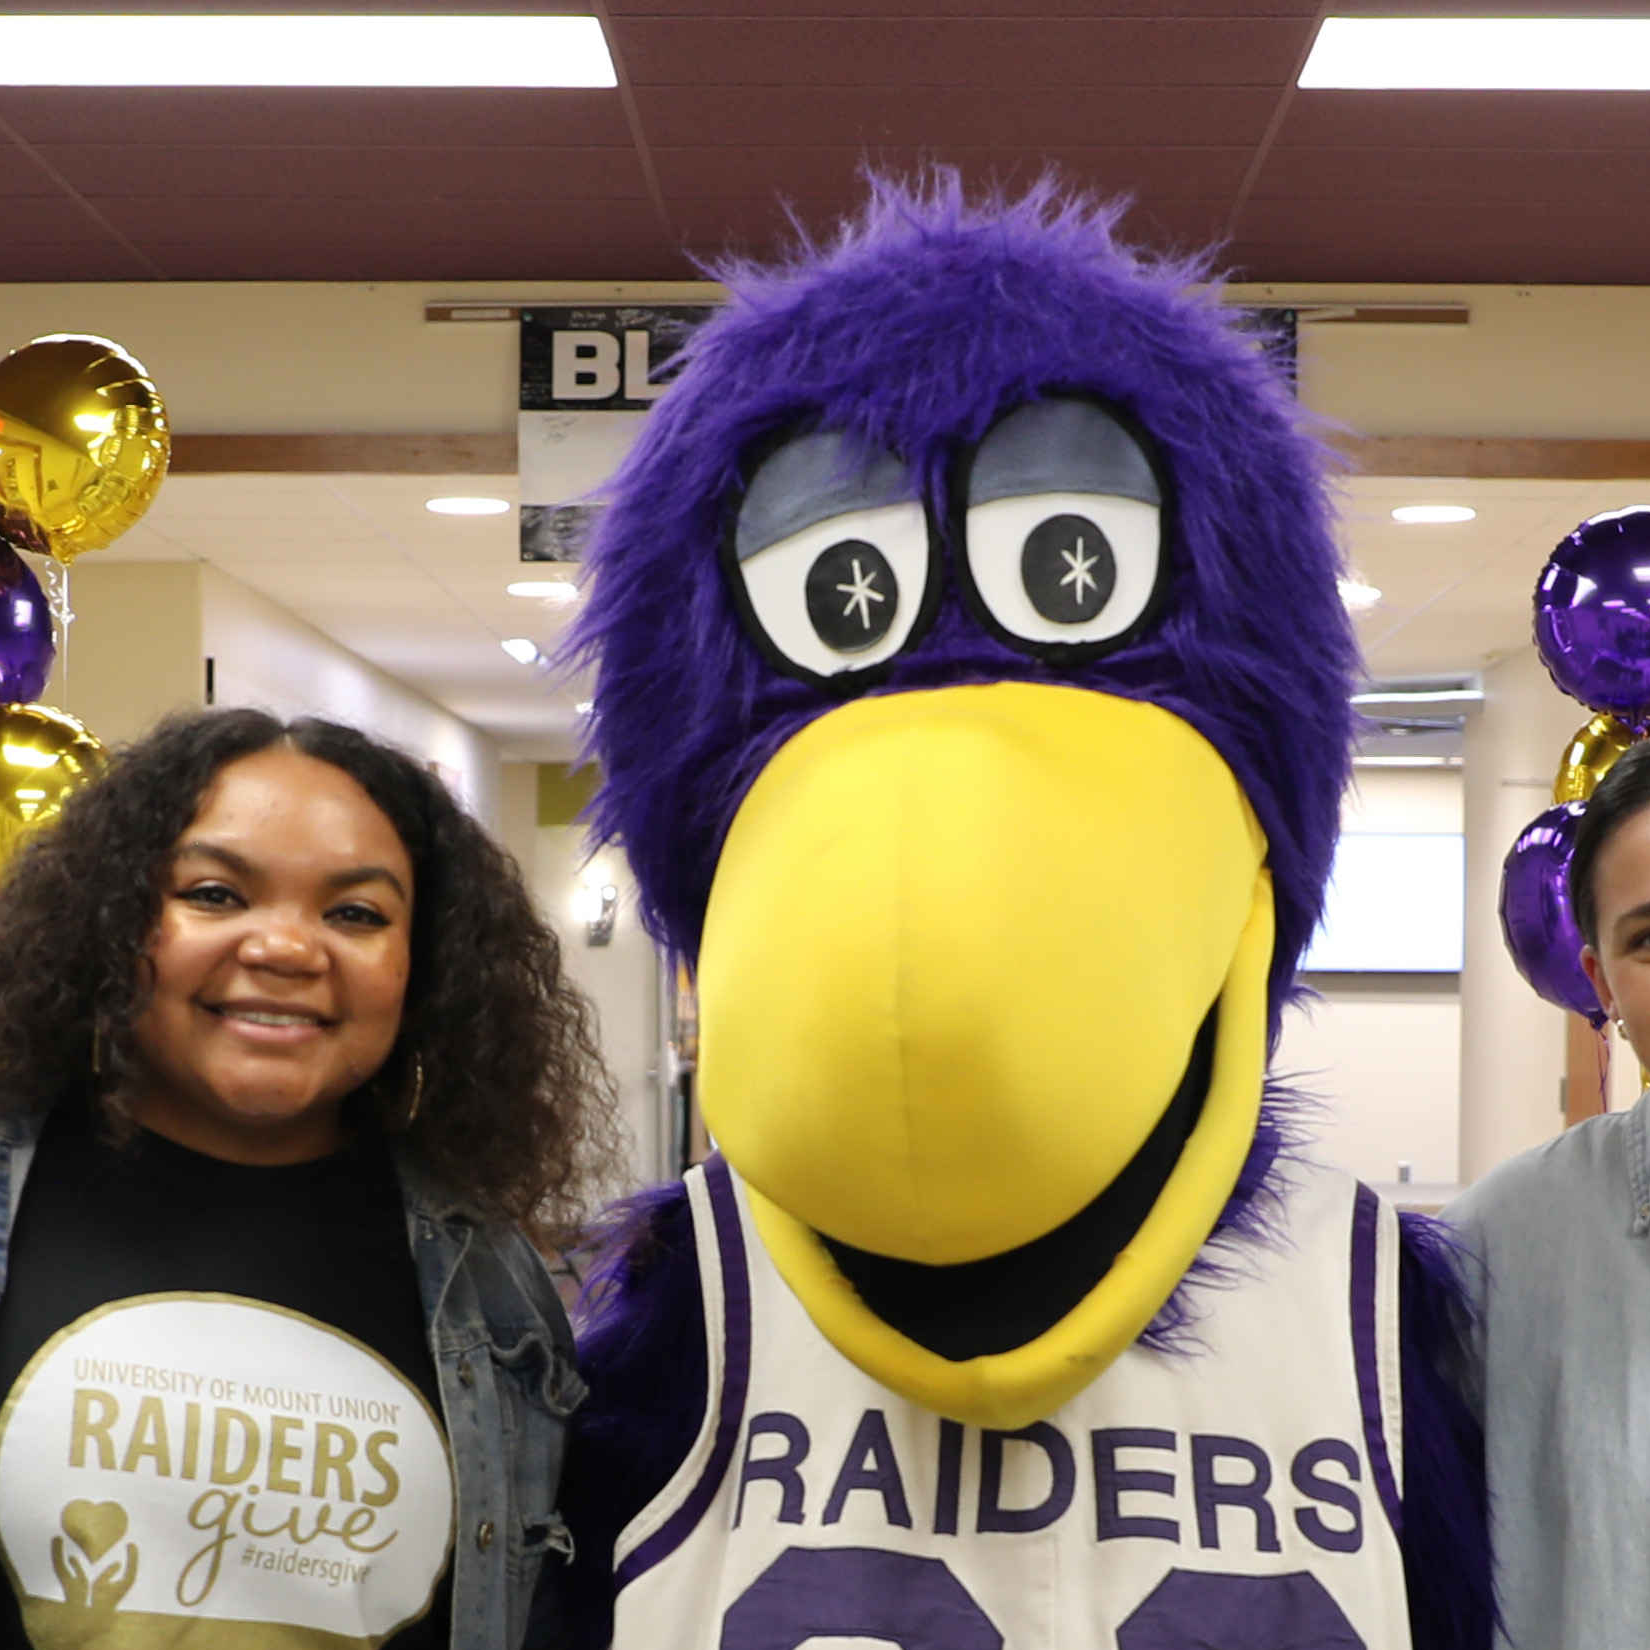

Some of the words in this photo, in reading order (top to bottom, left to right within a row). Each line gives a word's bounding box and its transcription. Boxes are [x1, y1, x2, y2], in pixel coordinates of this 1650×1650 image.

[68, 1387, 400, 1507] RAIDERS
[75, 1357, 204, 1392] UNIVERSITY
[209, 1378, 237, 1400] OF
[242, 1383, 321, 1414] MOUNT
[329, 1396, 397, 1425] UNION
[732, 1408, 1363, 1554] RAIDERS
[176, 1485, 398, 1606] give
